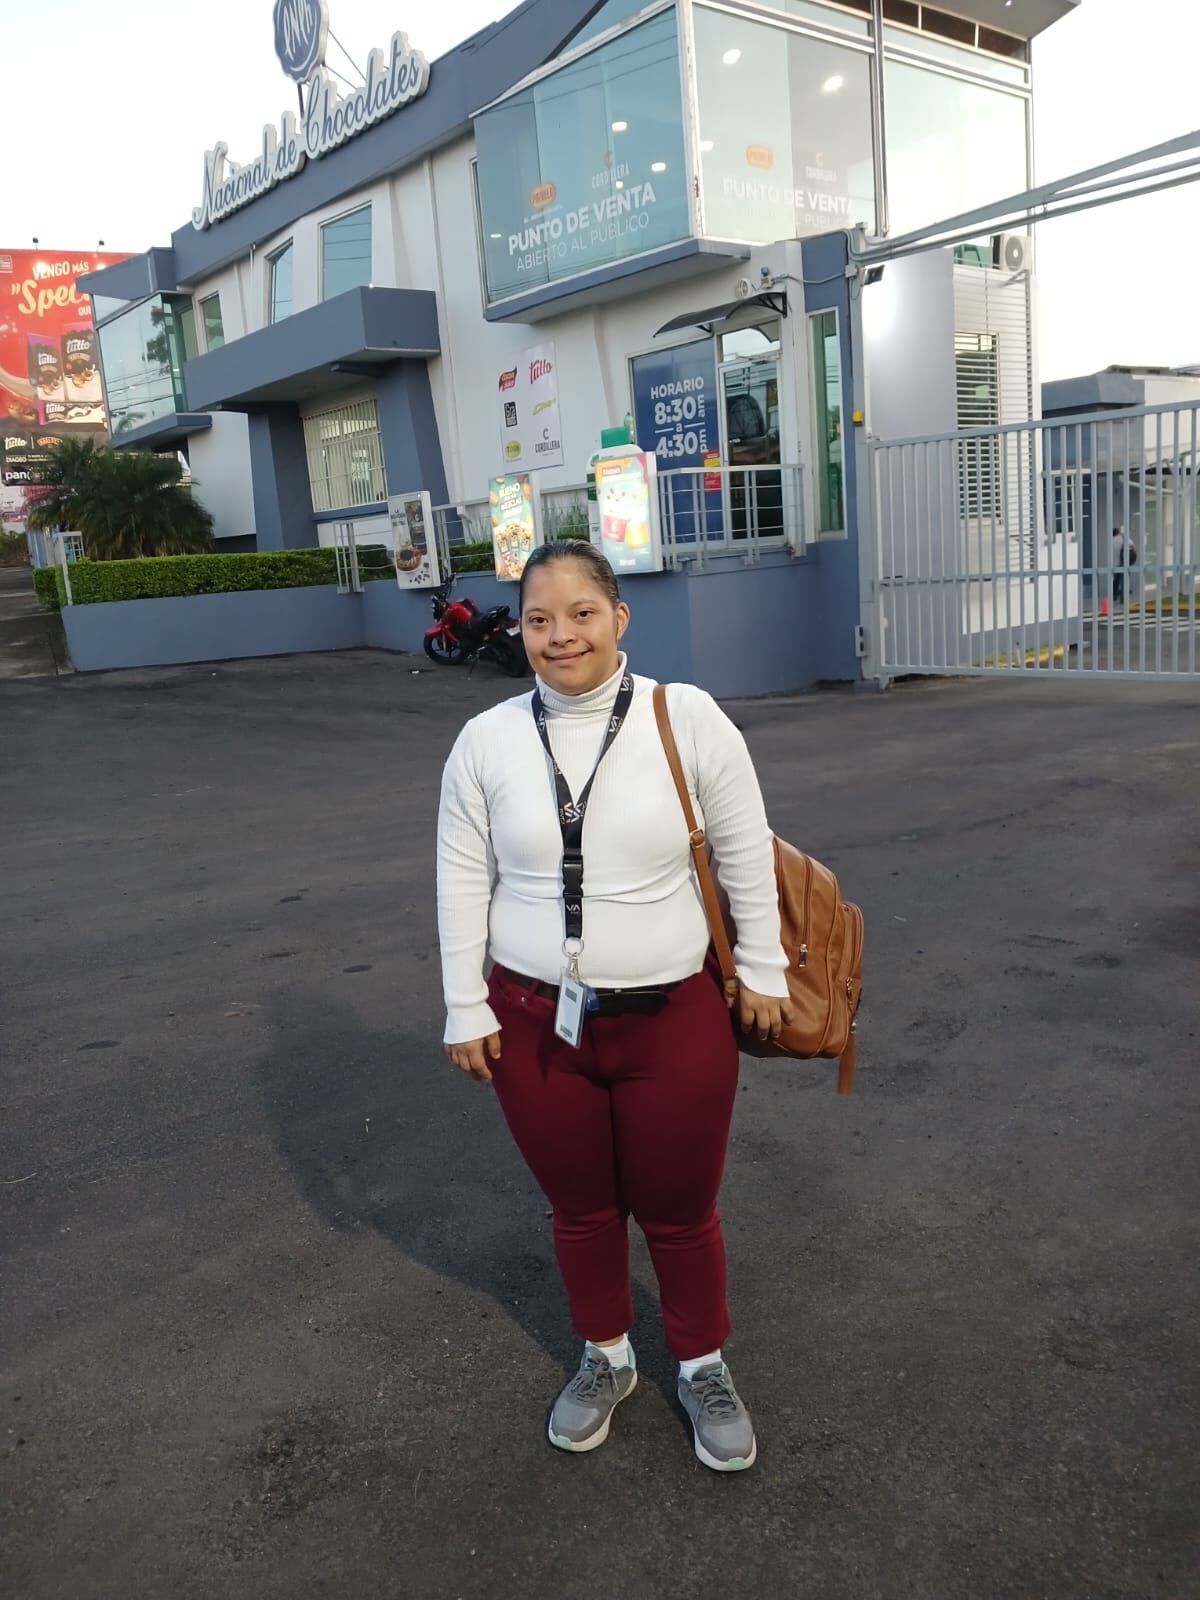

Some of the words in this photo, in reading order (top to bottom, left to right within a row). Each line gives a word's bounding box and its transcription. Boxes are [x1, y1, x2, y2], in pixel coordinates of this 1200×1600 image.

[193, 128, 272, 224] Nacional
[275, 116, 298, 174] de
[303, 38, 421, 154] Chocolates
[508, 216, 563, 255] PUNTO
[566, 206, 591, 233] DE
[592, 182, 657, 224] VENTA
[32, 261, 70, 280] VENGO
[72, 260, 89, 273] MÁS
[517, 242, 567, 272] ABIERTO
[571, 238, 588, 254] AL
[651, 377, 704, 399] HORARIO
[655, 396, 697, 425] 8:30
[698, 394, 706, 417] am
[676, 423, 683, 432] a
[656, 432, 699, 458] 4:30
[700, 429, 709, 453] pm
